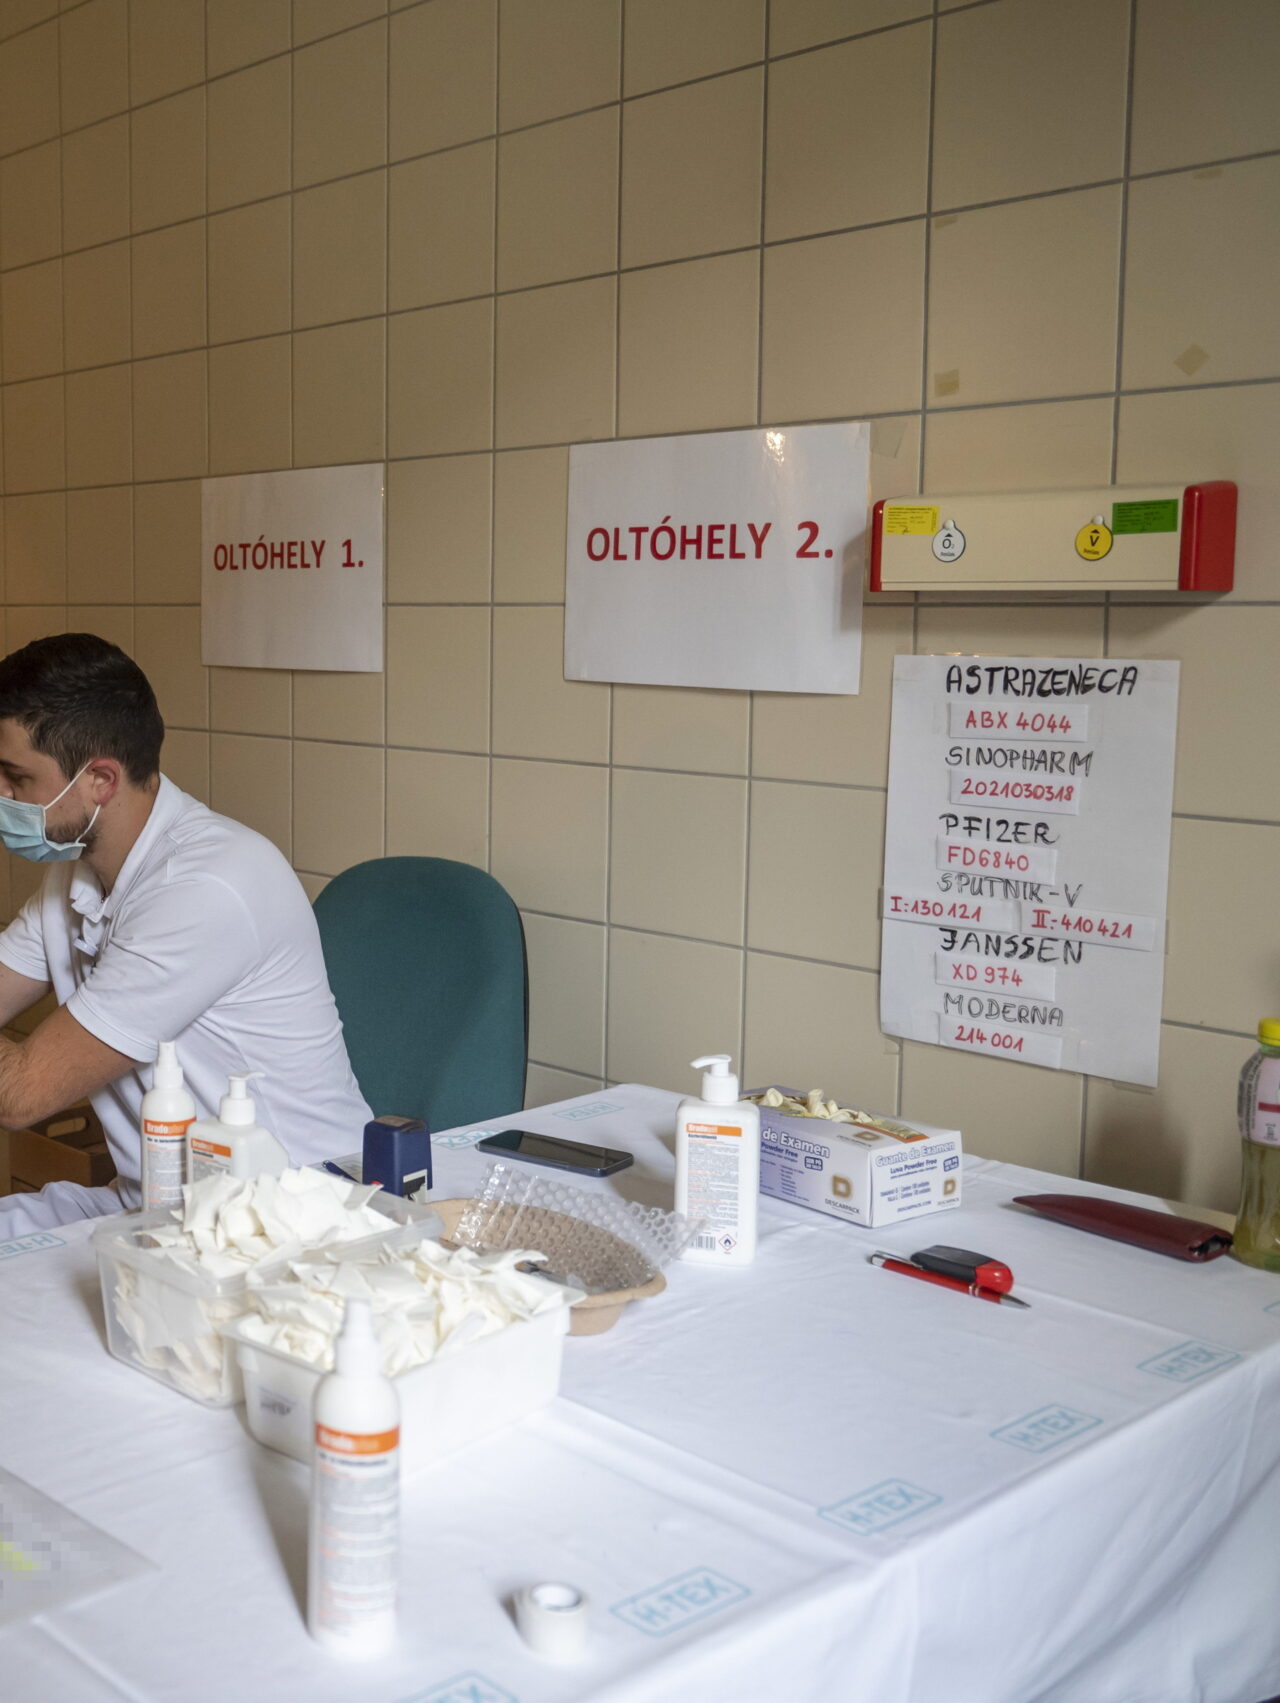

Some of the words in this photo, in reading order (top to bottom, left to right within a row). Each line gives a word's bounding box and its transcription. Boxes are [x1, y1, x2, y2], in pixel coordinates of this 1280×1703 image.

[213, 535, 326, 572] OLTÓHELY
[340, 538, 365, 569] 1.
[586, 515, 772, 562] OLTÓHELY
[795, 521, 834, 559] 2.
[1089, 535, 1100, 547] V
[945, 663, 1139, 697] ASTRAZENECA
[965, 709, 1008, 730] ABX
[1016, 711, 1071, 734] 4044
[945, 746, 1094, 777] SINOPHARM
[960, 778, 1075, 801] 2021030318
[939, 813, 1060, 846] PFIZER
[939, 927, 1084, 964] JANSSEN
[943, 992, 1064, 1027] MODERNA
[762, 1127, 778, 1142] de
[780, 1132, 830, 1159] Examen
[875, 1151, 908, 1168] Guante
[908, 1147, 920, 1161] de
[920, 1141, 956, 1158] Examen
[1158, 1345, 1217, 1376] H-TEX
[1015, 1409, 1081, 1446] H-TEX
[840, 1484, 916, 1526] H-TEX
[634, 1574, 730, 1626] H-TEX
